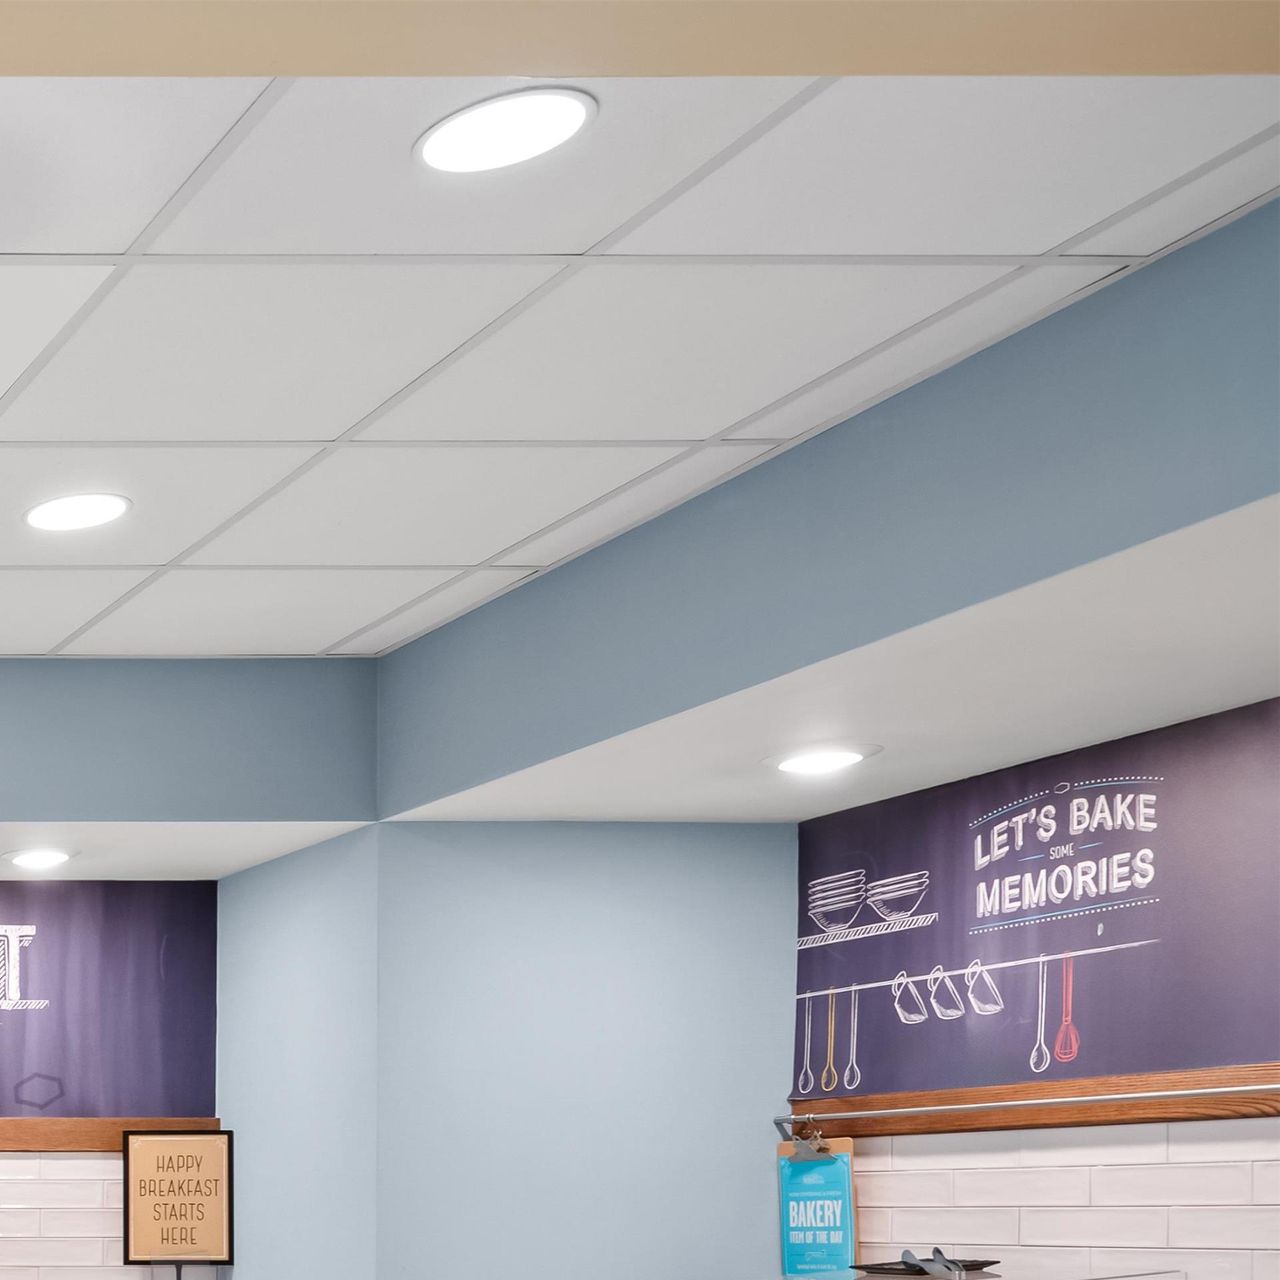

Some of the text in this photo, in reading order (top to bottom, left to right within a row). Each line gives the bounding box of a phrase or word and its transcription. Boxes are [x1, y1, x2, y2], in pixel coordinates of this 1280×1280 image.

[975, 794, 1157, 871] LET'S BAKE
[1049, 843, 1075, 860] SOME
[976, 848, 1155, 918] MEMORIES
[156, 1154, 203, 1173] HAPPY
[139, 1178, 220, 1197] BREAKFAST
[153, 1202, 205, 1221] STARTS
[789, 1200, 842, 1227] BAKERY
[161, 1227, 197, 1245] HERE
[790, 1231, 843, 1243] ITEM OF THE DAY
